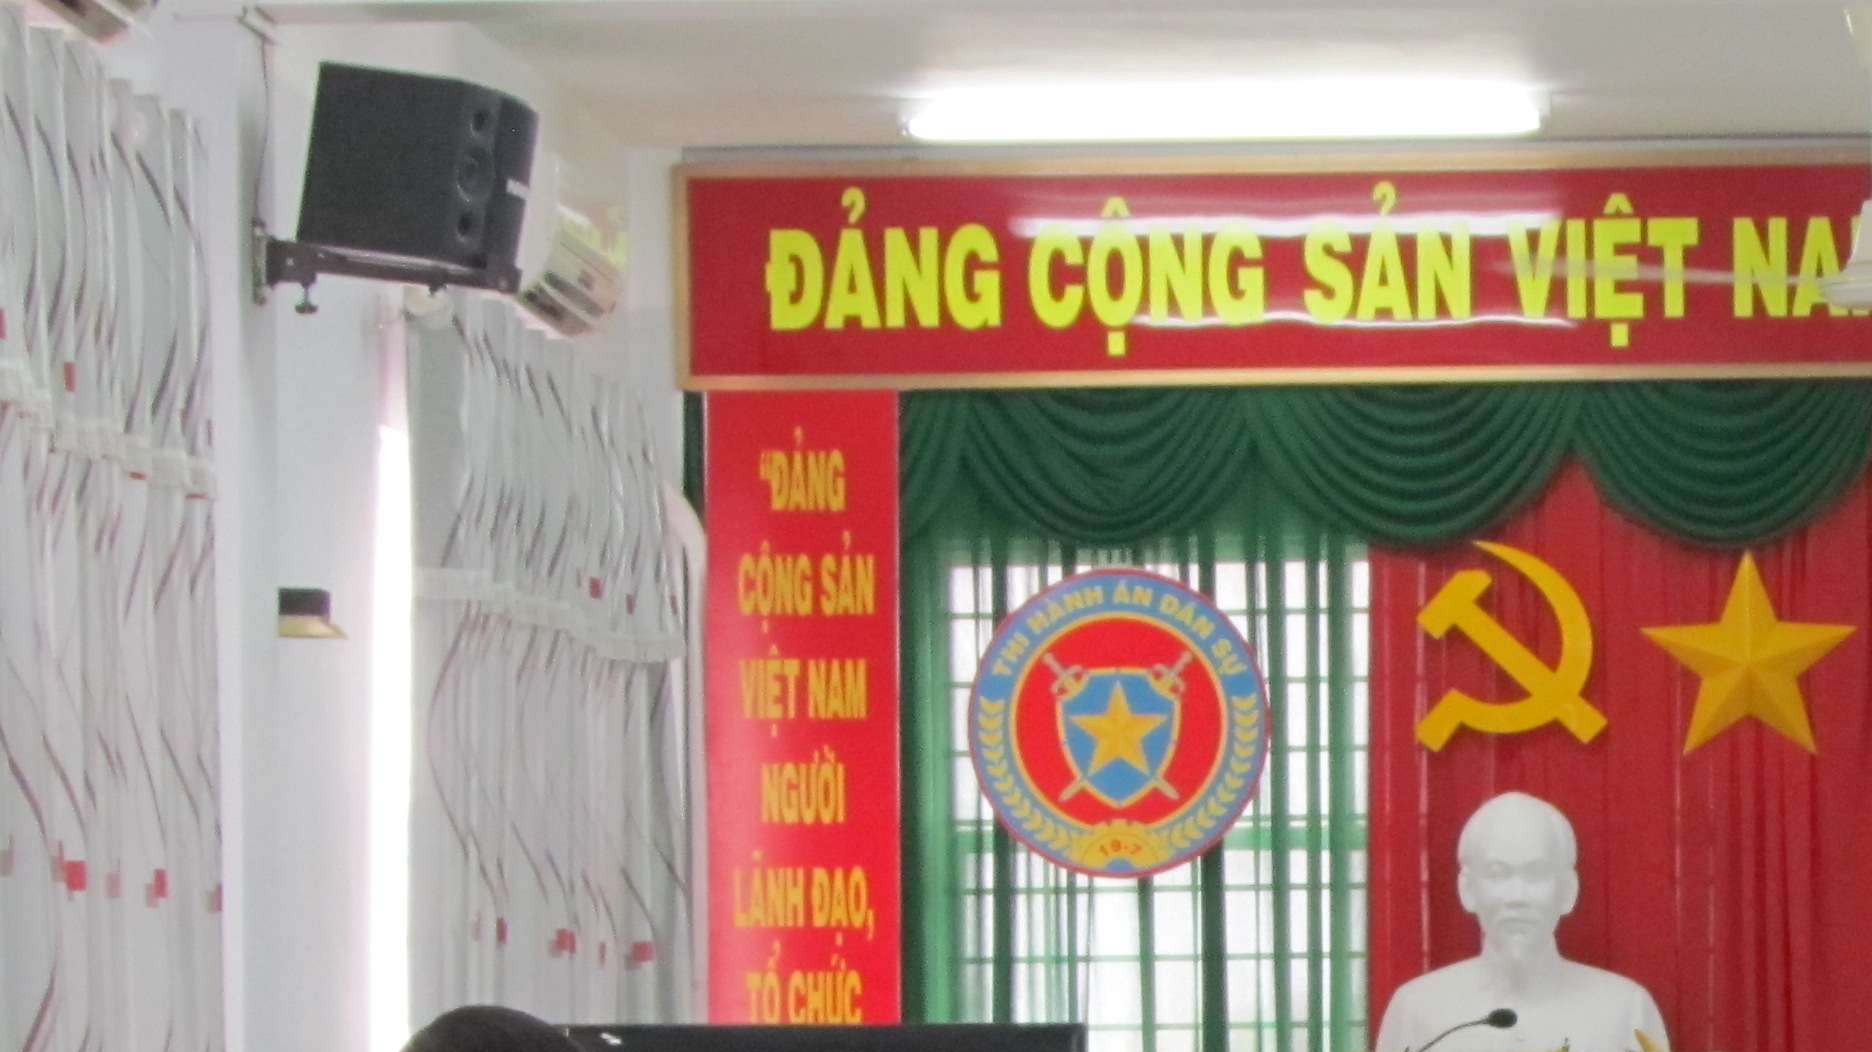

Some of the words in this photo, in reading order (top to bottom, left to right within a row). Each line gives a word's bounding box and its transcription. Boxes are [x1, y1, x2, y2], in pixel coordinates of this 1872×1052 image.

[765, 186, 1000, 330] ĐẢNG
[1028, 196, 1265, 356] CỘNG
[1303, 181, 1472, 323] SẢN
[1508, 192, 1698, 347] VIỆT
[738, 539, 813, 633] CỘNG
[820, 529, 875, 616] SẢN
[739, 644, 801, 738] VIỆT
[808, 658, 868, 720] NAM
[760, 745, 846, 824] NGƯỜI
[733, 849, 804, 927] LÃNH
[812, 865, 875, 946] ĐẠO,
[745, 939, 781, 1024] TỔ
[788, 953, 863, 1024] CHỨC
